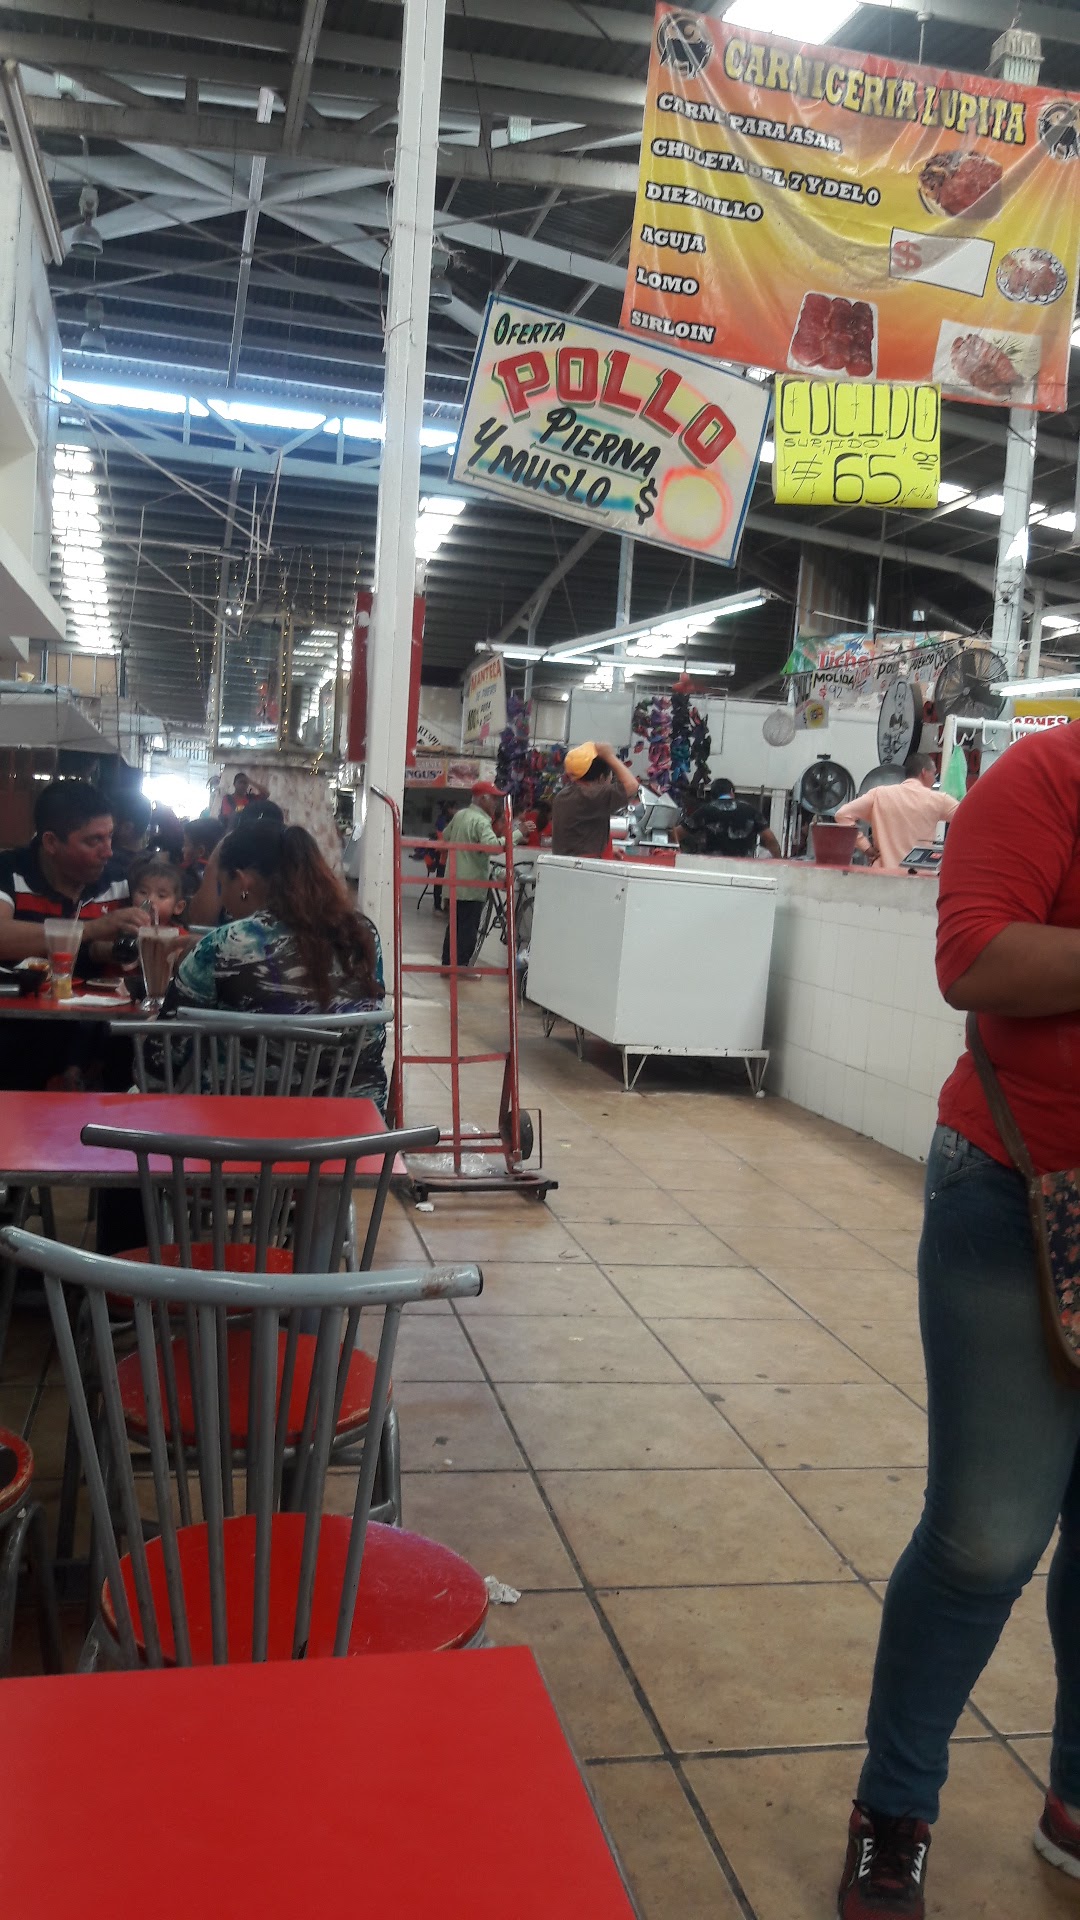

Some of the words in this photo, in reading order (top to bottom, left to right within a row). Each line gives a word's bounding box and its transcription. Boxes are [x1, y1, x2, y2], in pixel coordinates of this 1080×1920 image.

[723, 37, 918, 121] CARNICERIA
[919, 85, 1027, 145] LUPITA
[729, 112, 787, 142] PARA
[788, 125, 843, 153] ASAR
[651, 138, 745, 173] CHULETA
[747, 162, 787, 189] DEL
[789, 171, 804, 191] 7
[804, 174, 823, 195] Y
[822, 178, 866, 204] DEL
[645, 180, 764, 222] DIEZMILLO
[640, 223, 706, 254] AGUJA
[892, 240, 922, 272] $
[635, 265, 700, 296] LOMO
[631, 309, 717, 344] SIRLOIN
[491, 347, 737, 469] POLLO
[780, 379, 938, 442] COCIDO
[539, 407, 661, 477] PIERNA
[784, 438, 880, 455] SURTIDO
[488, 445, 612, 508] MUSLO
[634, 477, 658, 525] $
